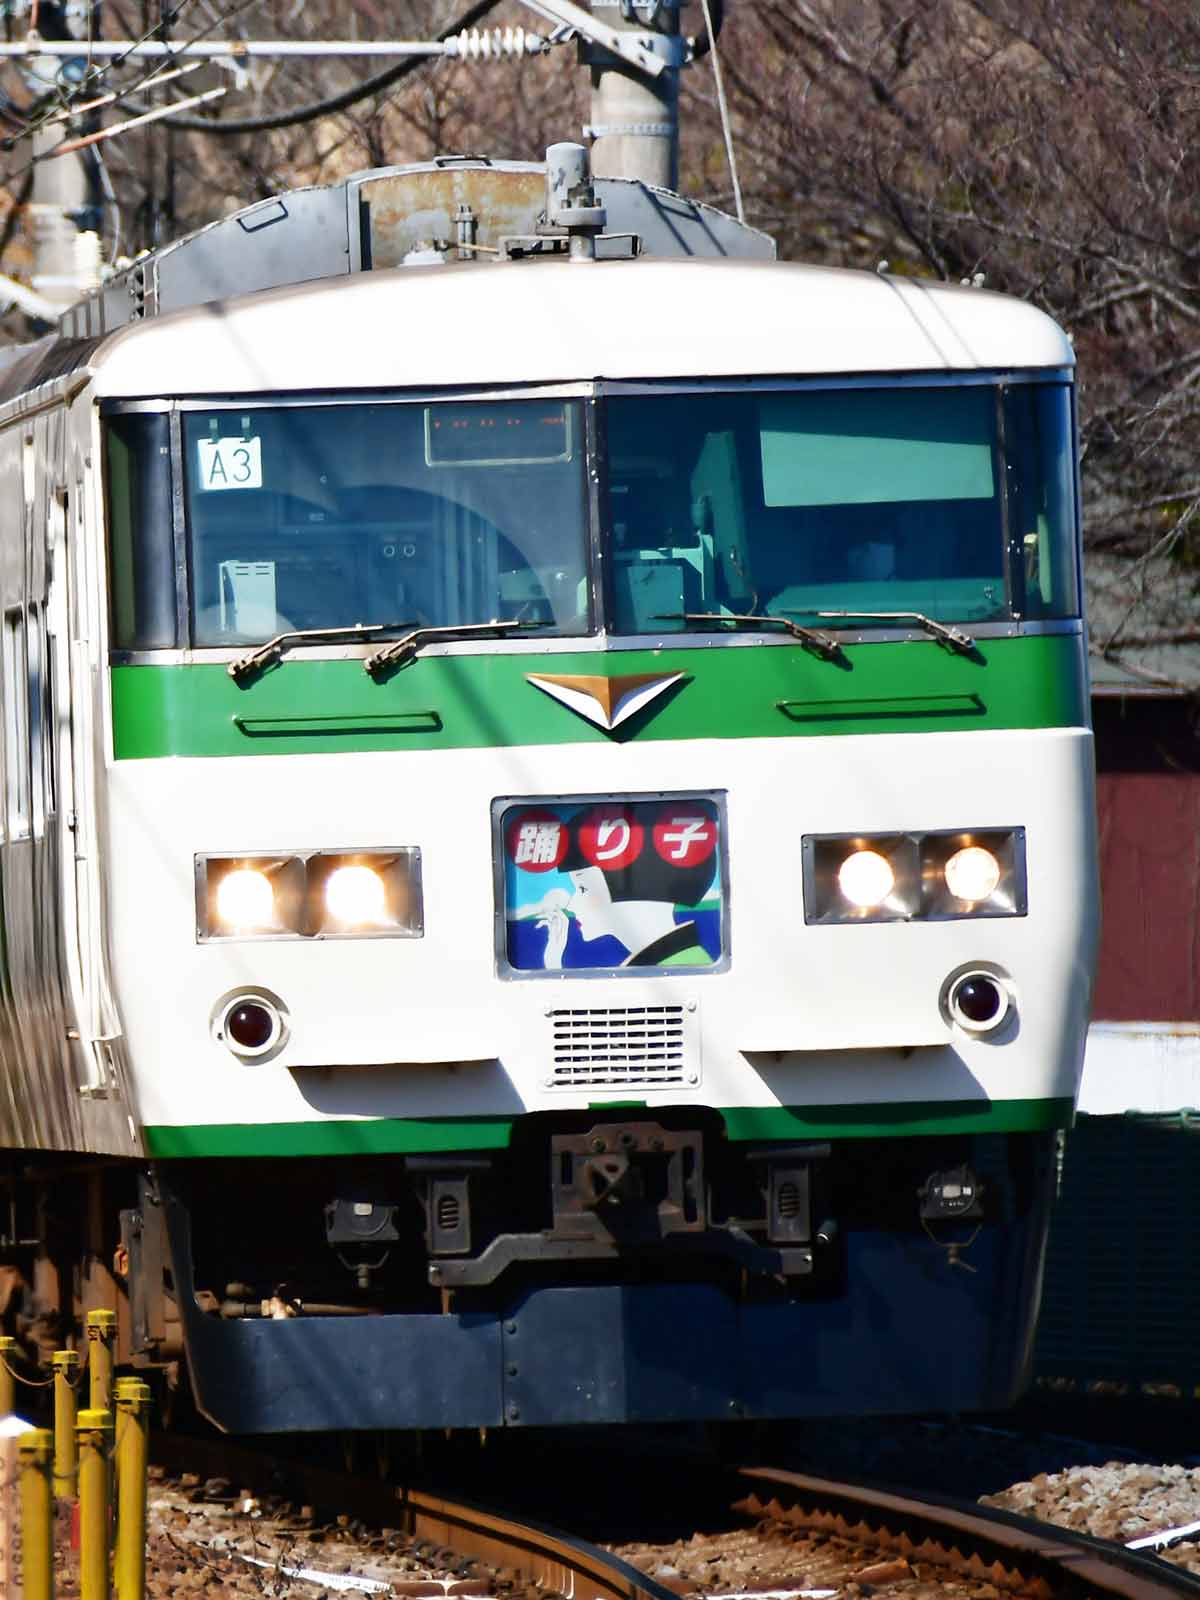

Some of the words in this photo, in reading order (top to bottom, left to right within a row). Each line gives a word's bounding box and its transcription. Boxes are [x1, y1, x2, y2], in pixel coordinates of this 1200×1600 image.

[209, 448, 252, 485] A3
[515, 817, 708, 863] 踊り子
